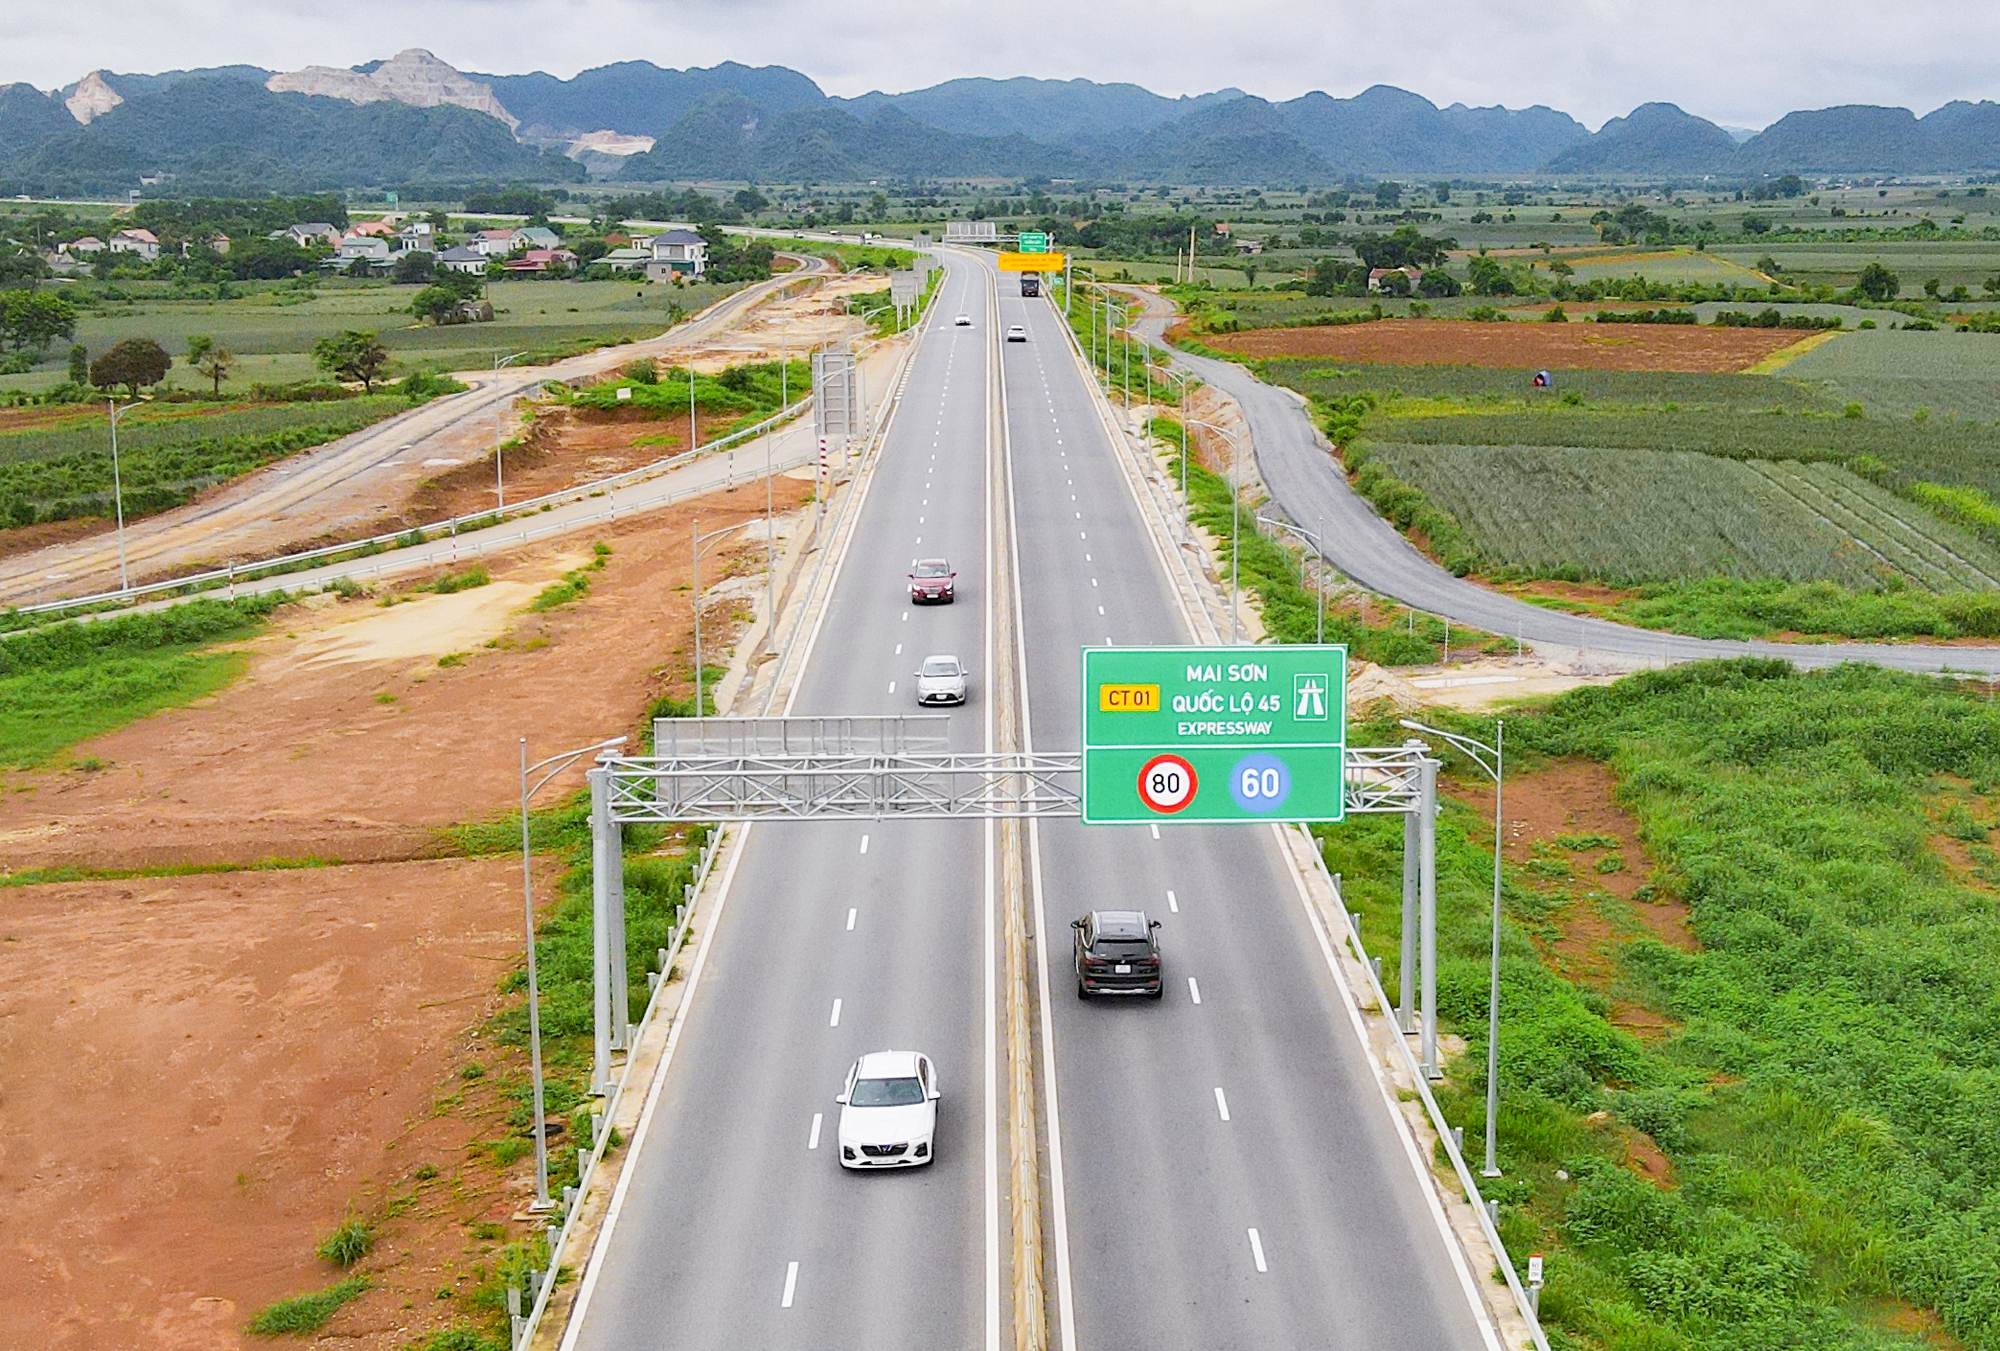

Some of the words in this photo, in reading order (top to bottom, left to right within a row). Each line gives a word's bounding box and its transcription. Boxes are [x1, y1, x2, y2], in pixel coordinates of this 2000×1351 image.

[1186, 665, 1221, 682] MAI
[1228, 663, 1267, 682] SƠN
[1172, 688, 1224, 712] QUỐC
[1229, 692, 1254, 715] LỘ
[1257, 695, 1280, 712] 45
[1178, 721, 1272, 736] EXPRESSWAY
[1152, 773, 1180, 794] 80
[1241, 768, 1279, 798] 60
